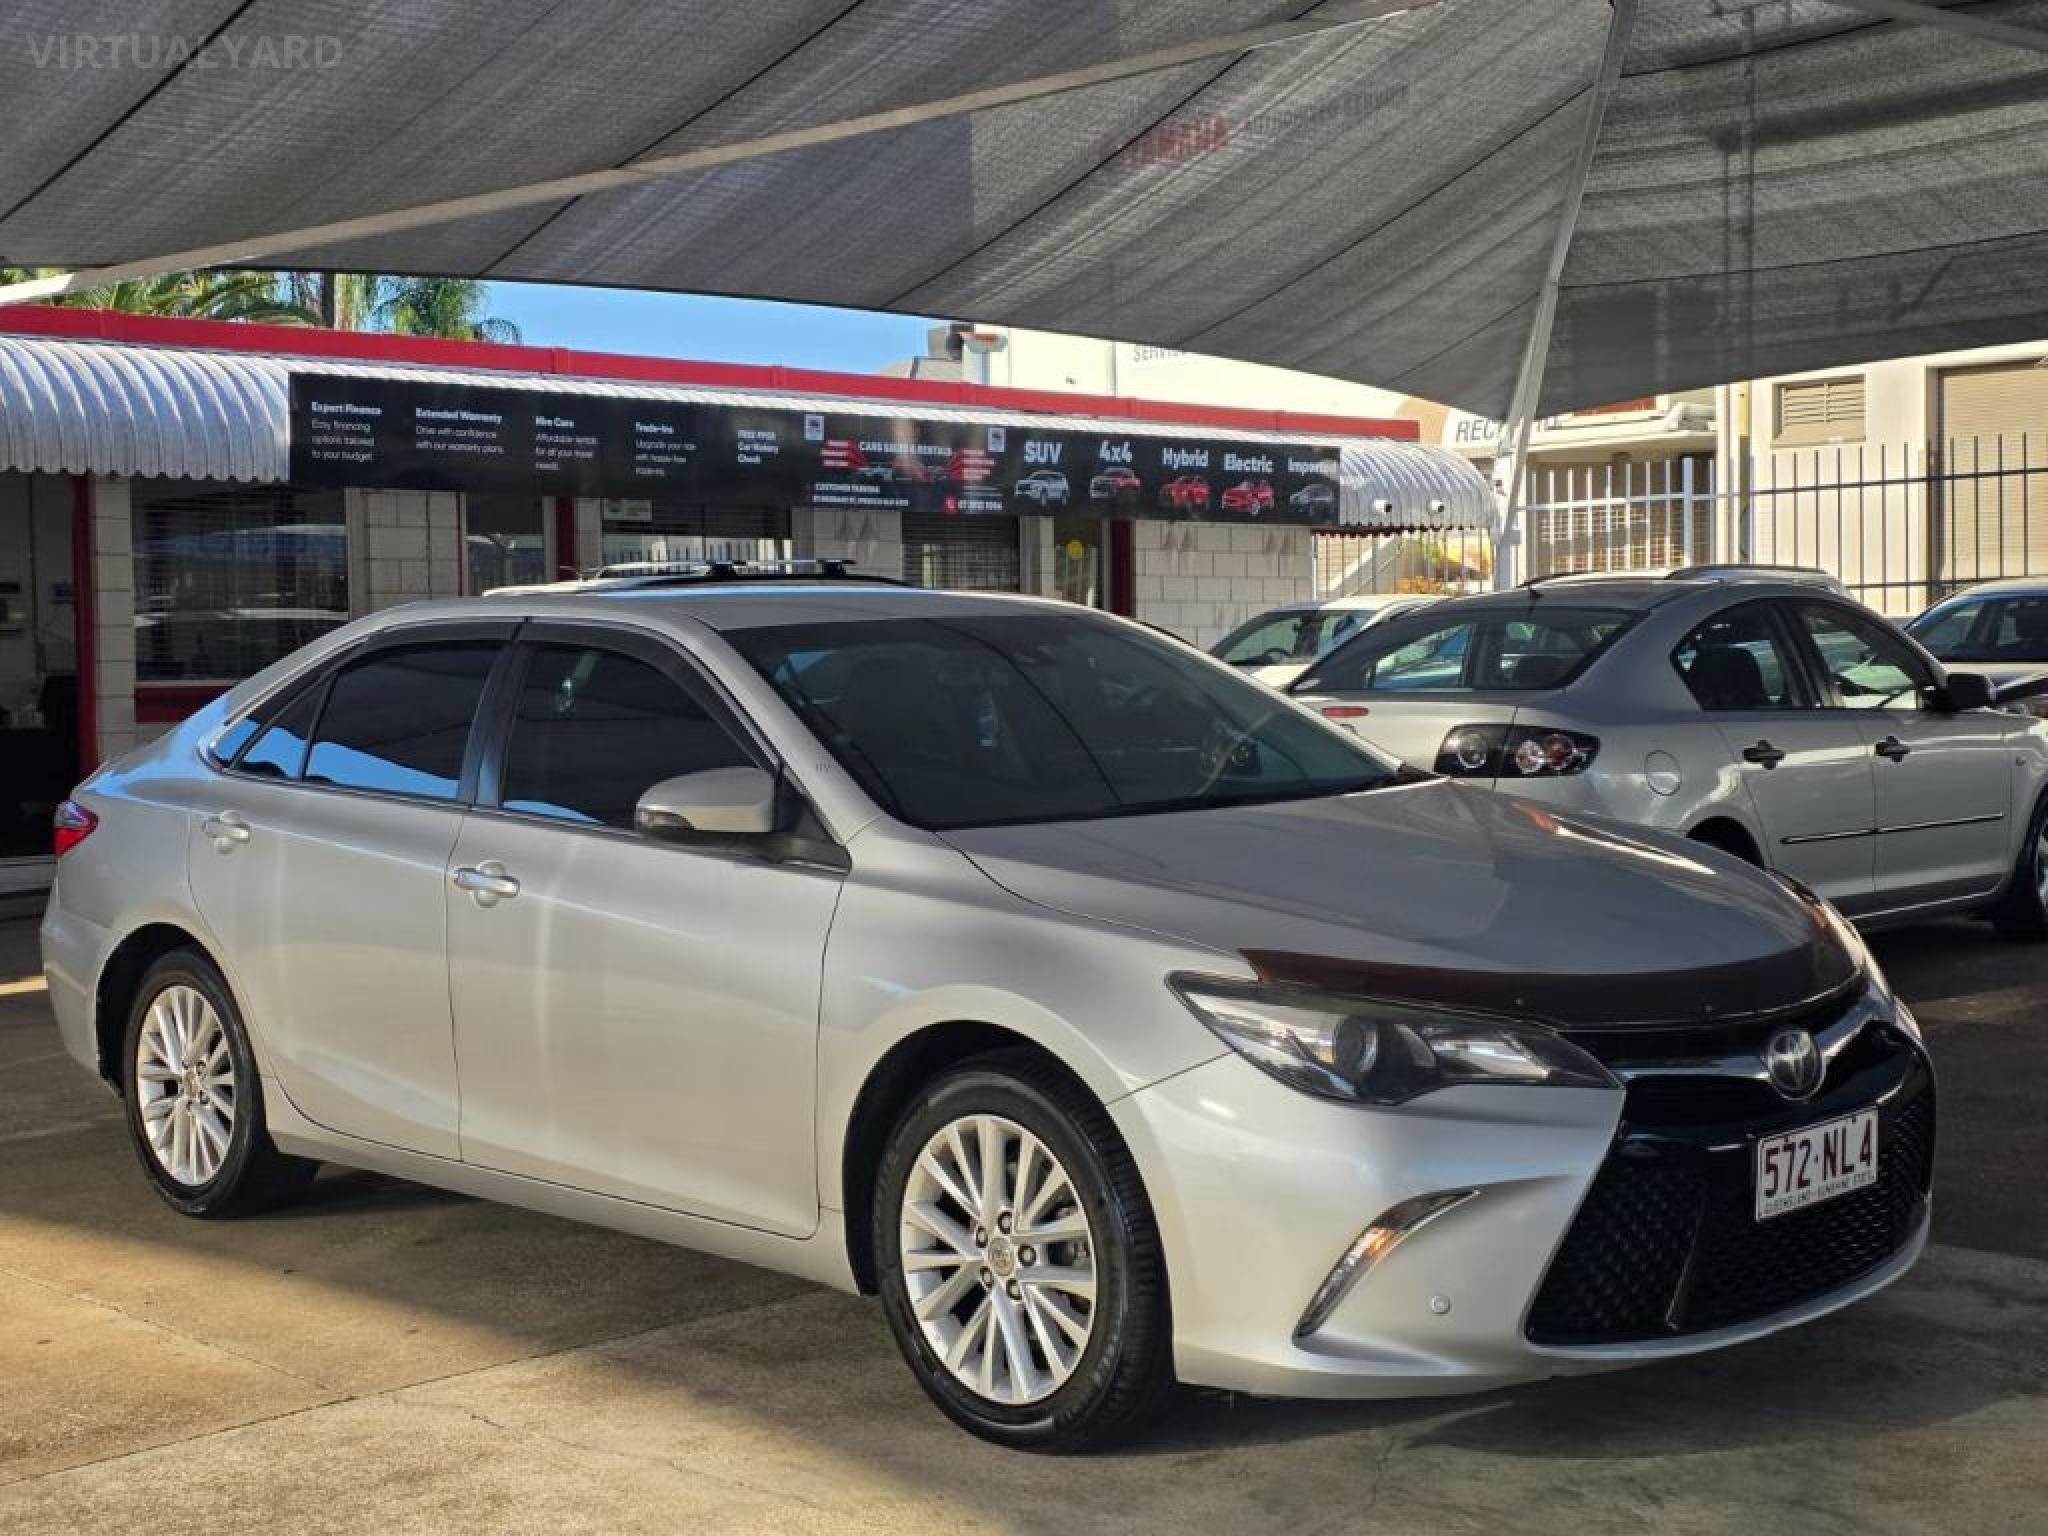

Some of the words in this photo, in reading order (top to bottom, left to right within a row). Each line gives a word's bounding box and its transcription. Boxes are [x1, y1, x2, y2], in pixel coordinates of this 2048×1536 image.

[311, 401, 343, 414] Expert
[345, 403, 382, 415] Finance
[415, 407, 459, 419] Extended
[459, 411, 503, 424] Warranty
[311, 418, 331, 430] Easy
[333, 419, 371, 432] financing
[415, 425, 437, 435] Drive
[438, 427, 454, 436] with
[454, 428, 497, 439] confidence
[415, 440, 433, 449] with
[447, 443, 480, 454] warranty
[1023, 441, 1063, 464] SUV
[1100, 440, 1133, 463] 4x4
[322, 451, 340, 461] your
[1162, 448, 1209, 469] Hybrid
[1223, 454, 1274, 473] Electric
